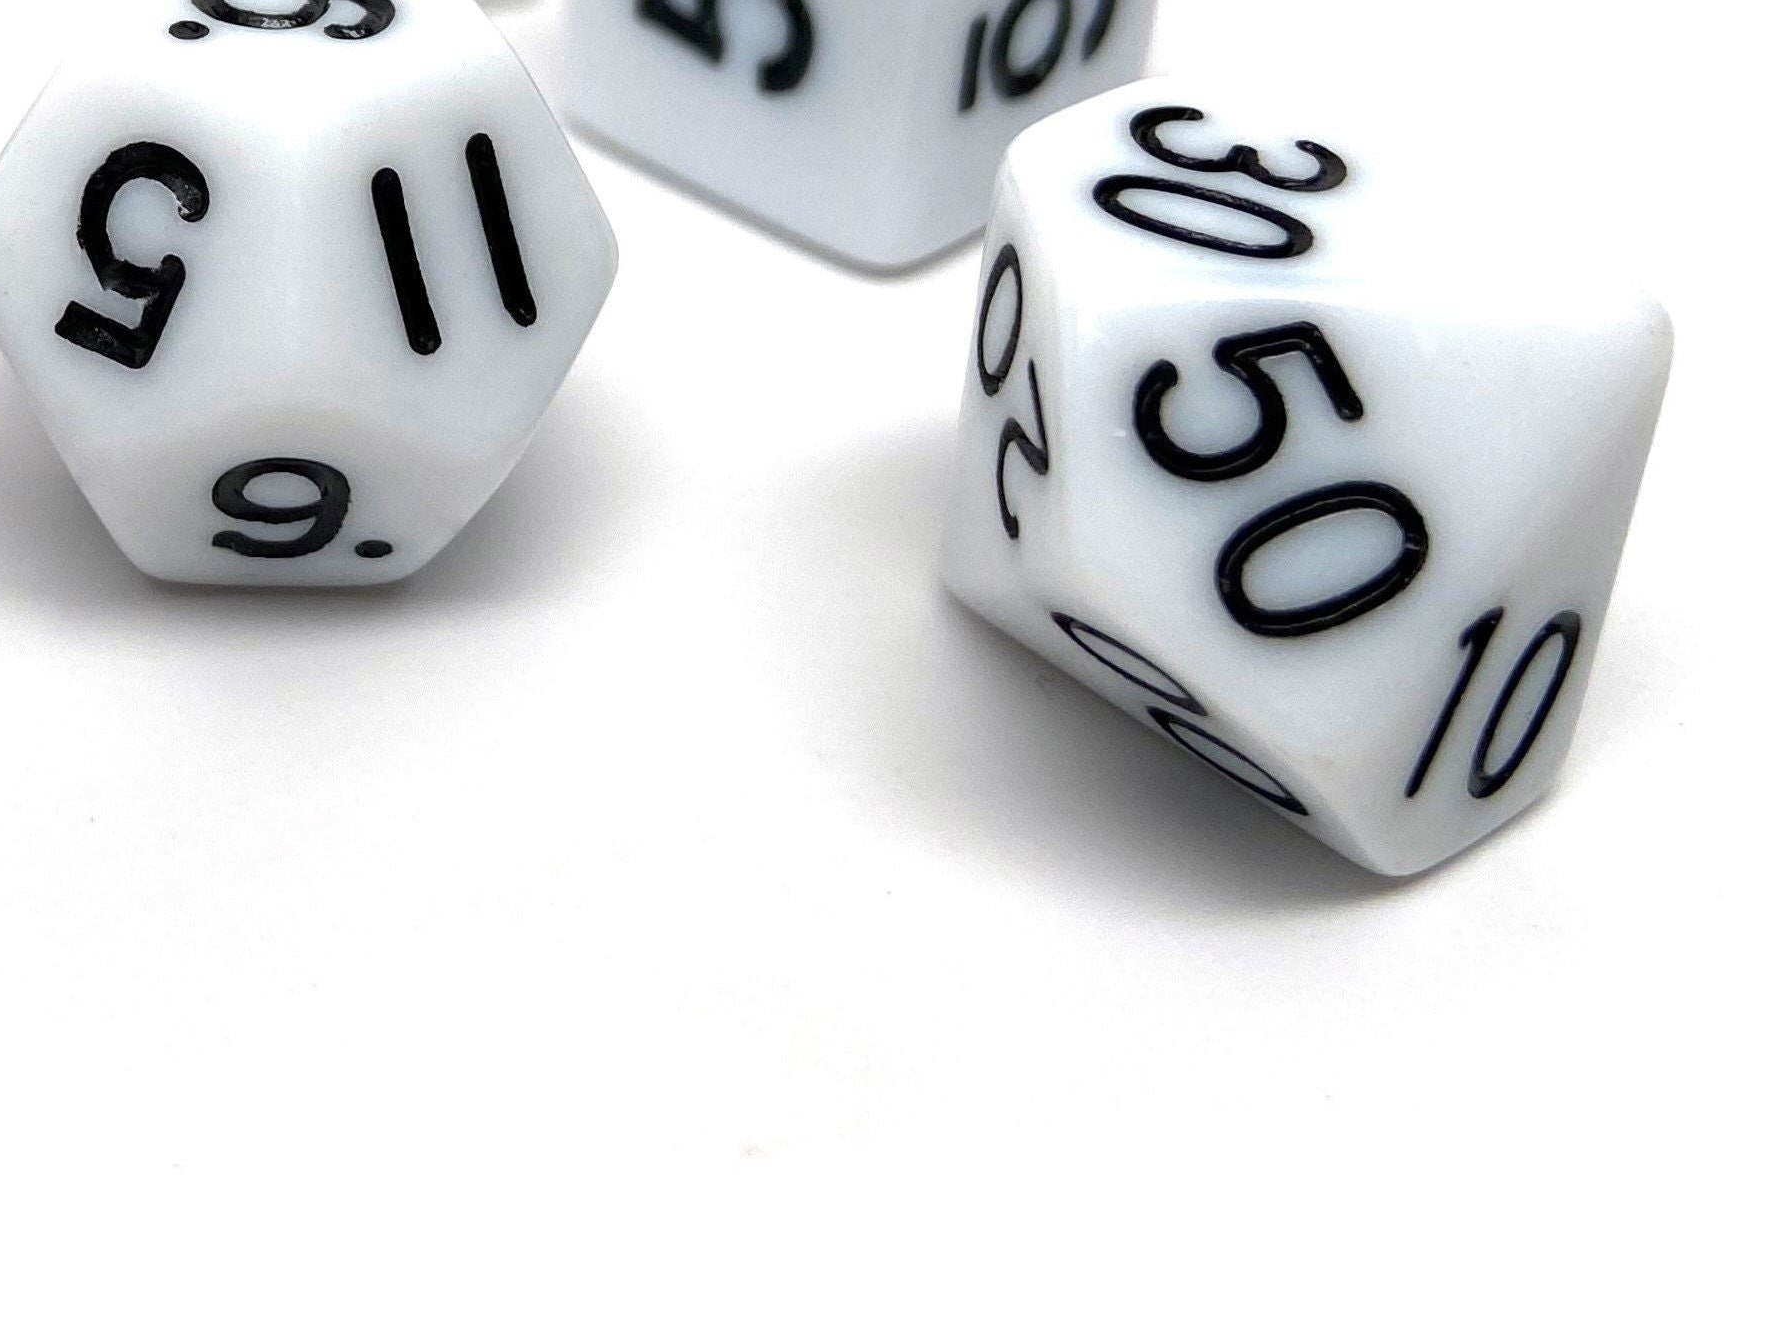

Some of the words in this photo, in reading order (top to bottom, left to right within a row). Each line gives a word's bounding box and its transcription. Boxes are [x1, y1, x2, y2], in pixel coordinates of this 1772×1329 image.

[54, 141, 210, 370] 5
[369, 133, 538, 357] 11
[1092, 106, 1347, 260] 30
[1131, 321, 1431, 642] 50
[1049, 610, 1311, 818] 00
[1403, 604, 1584, 802] 10
